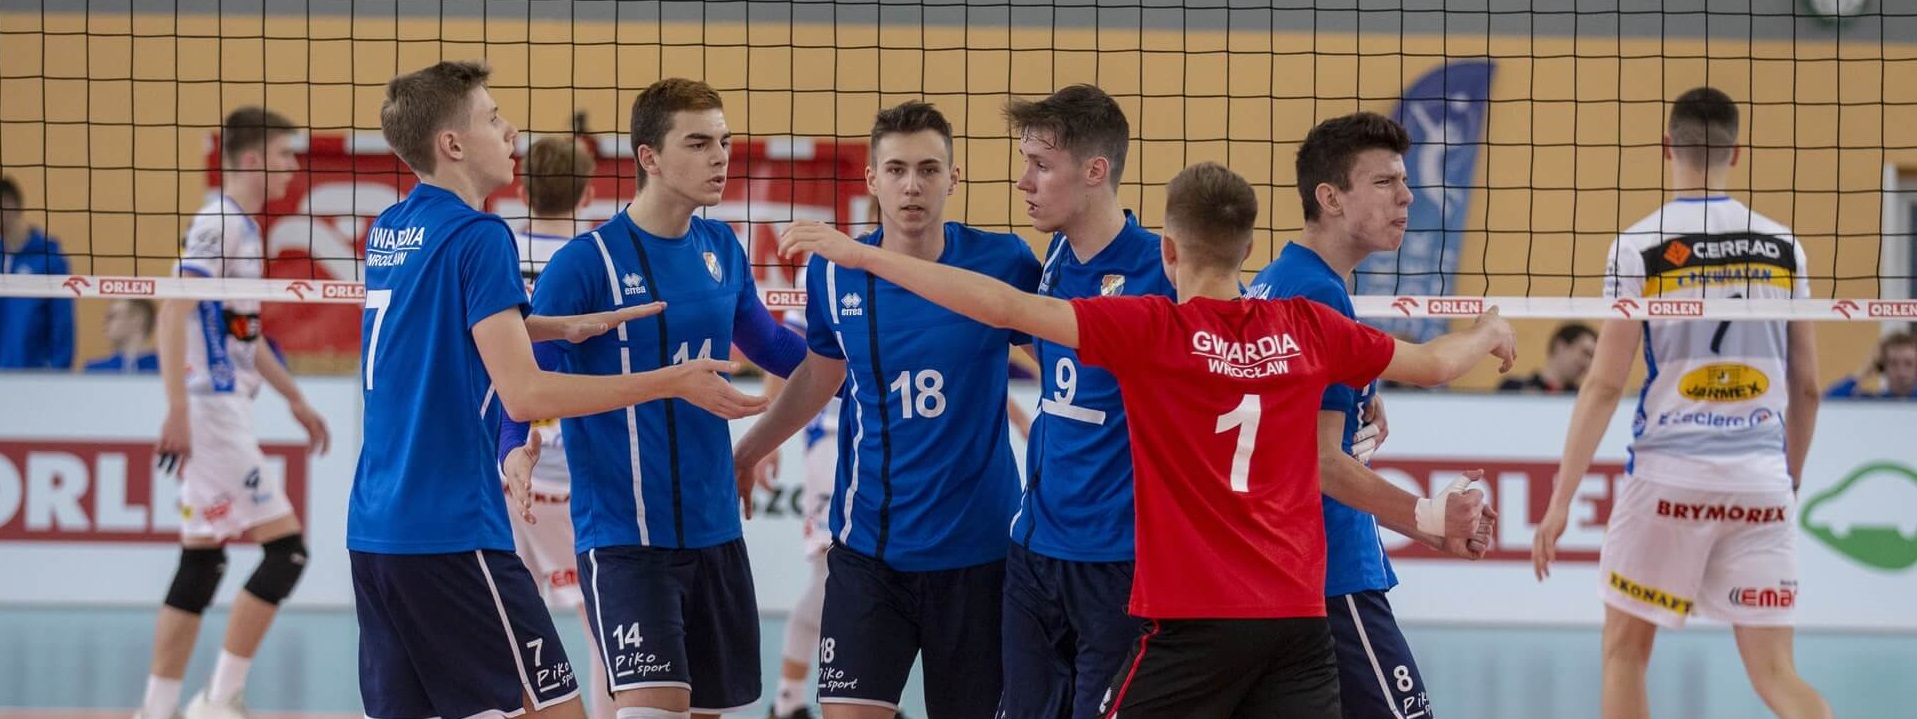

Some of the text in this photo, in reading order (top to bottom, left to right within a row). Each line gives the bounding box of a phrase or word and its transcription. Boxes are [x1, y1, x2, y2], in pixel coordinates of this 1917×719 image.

[1693, 239, 1781, 259] CERRAD
[101, 281, 153, 295] ORLEN
[325, 284, 365, 298] ORLE
[768, 292, 807, 305] ORLE
[1430, 301, 1482, 314] ORLEN
[1650, 302, 1700, 315] ORLEN
[364, 289, 392, 390] 7
[1192, 331, 1300, 364] GWARDIA
[1208, 359, 1289, 378] WROCŁAW
[1053, 357, 1077, 405] 9
[1686, 382, 1762, 399] JARMEX
[890, 368, 946, 419] 18
[1215, 394, 1261, 492] 1
[1657, 499, 1786, 523] BRYMOREX
[1609, 572, 1694, 614] EKONAFT
[612, 622, 644, 650] 14
[526, 638, 543, 667] 7
[637, 662, 672, 677] sport
[1393, 665, 1414, 692] 8
[827, 678, 858, 692] sport
